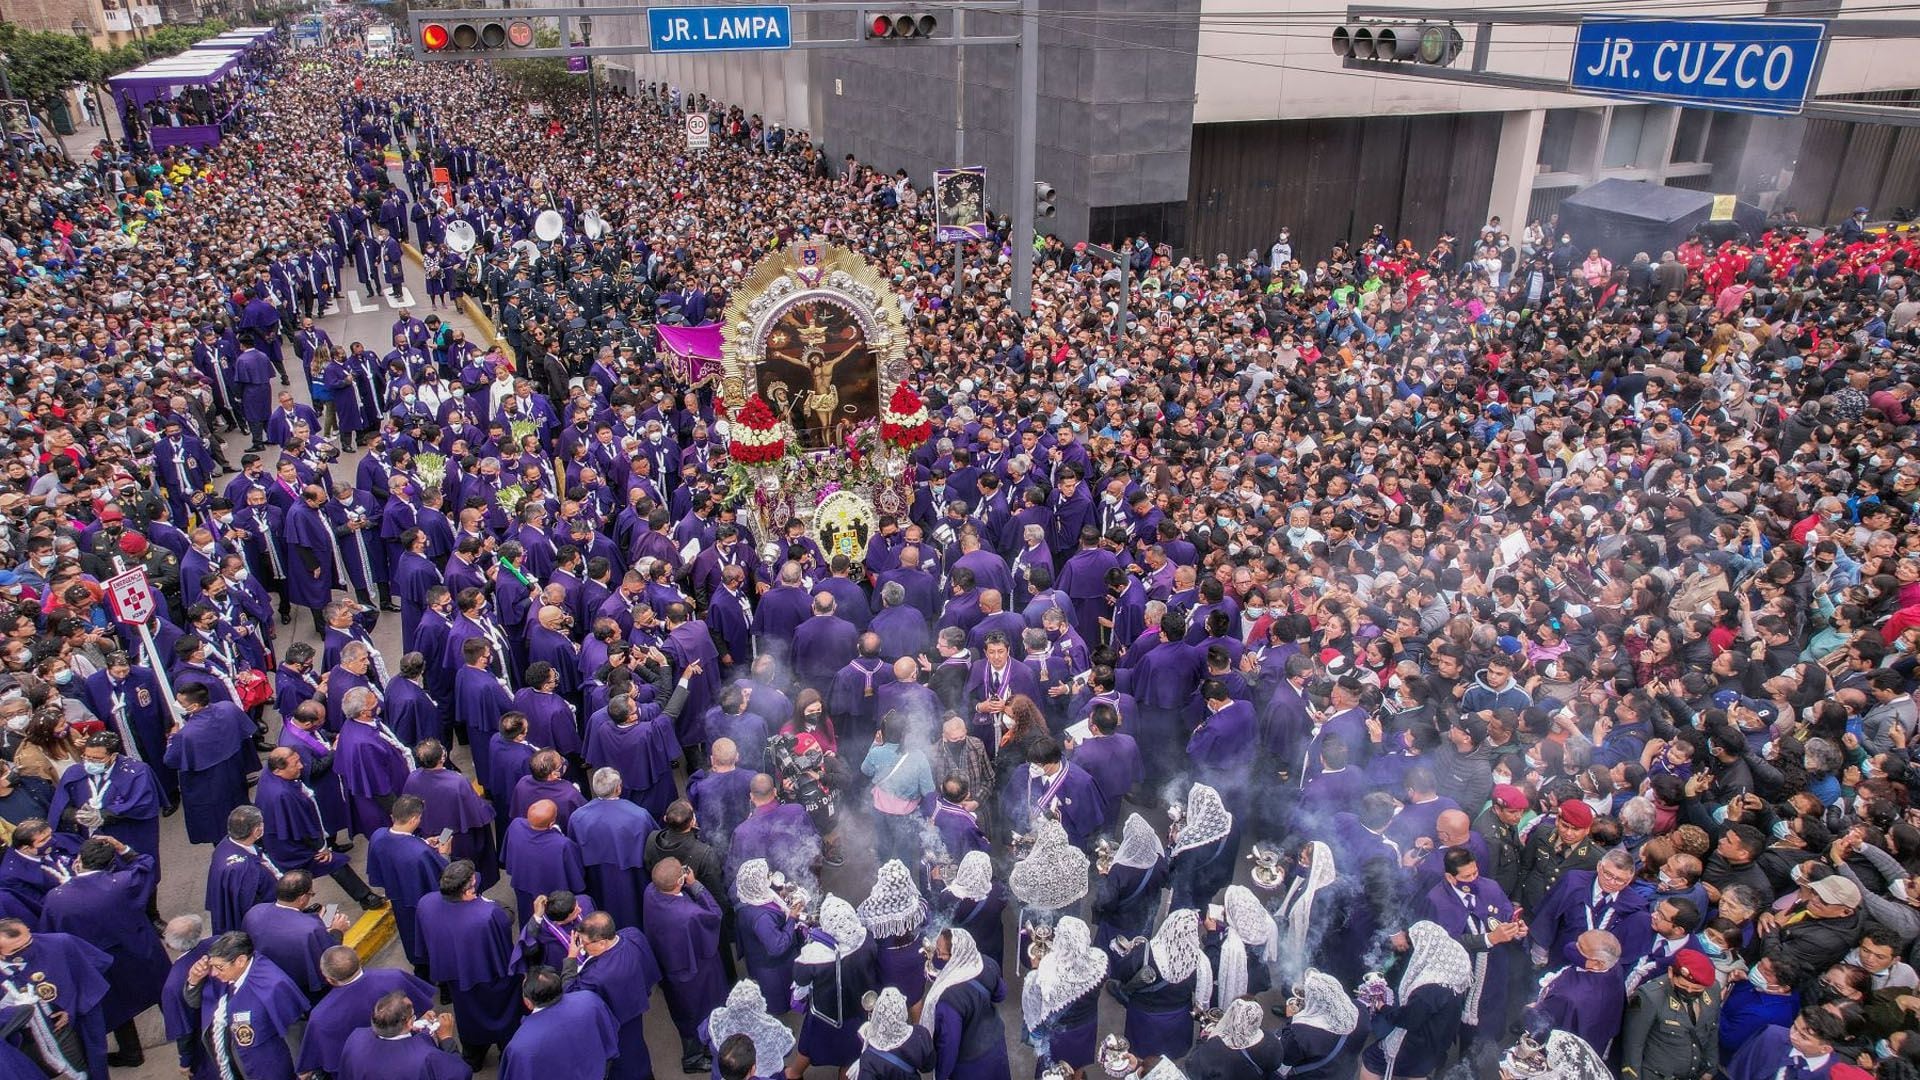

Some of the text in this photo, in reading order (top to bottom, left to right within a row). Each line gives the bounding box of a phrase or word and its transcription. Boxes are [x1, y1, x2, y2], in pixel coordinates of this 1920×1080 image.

[661, 16, 781, 42] JR. LAMPA
[1587, 37, 1794, 91] JR. CUZCO
[691, 120, 704, 129] 30
